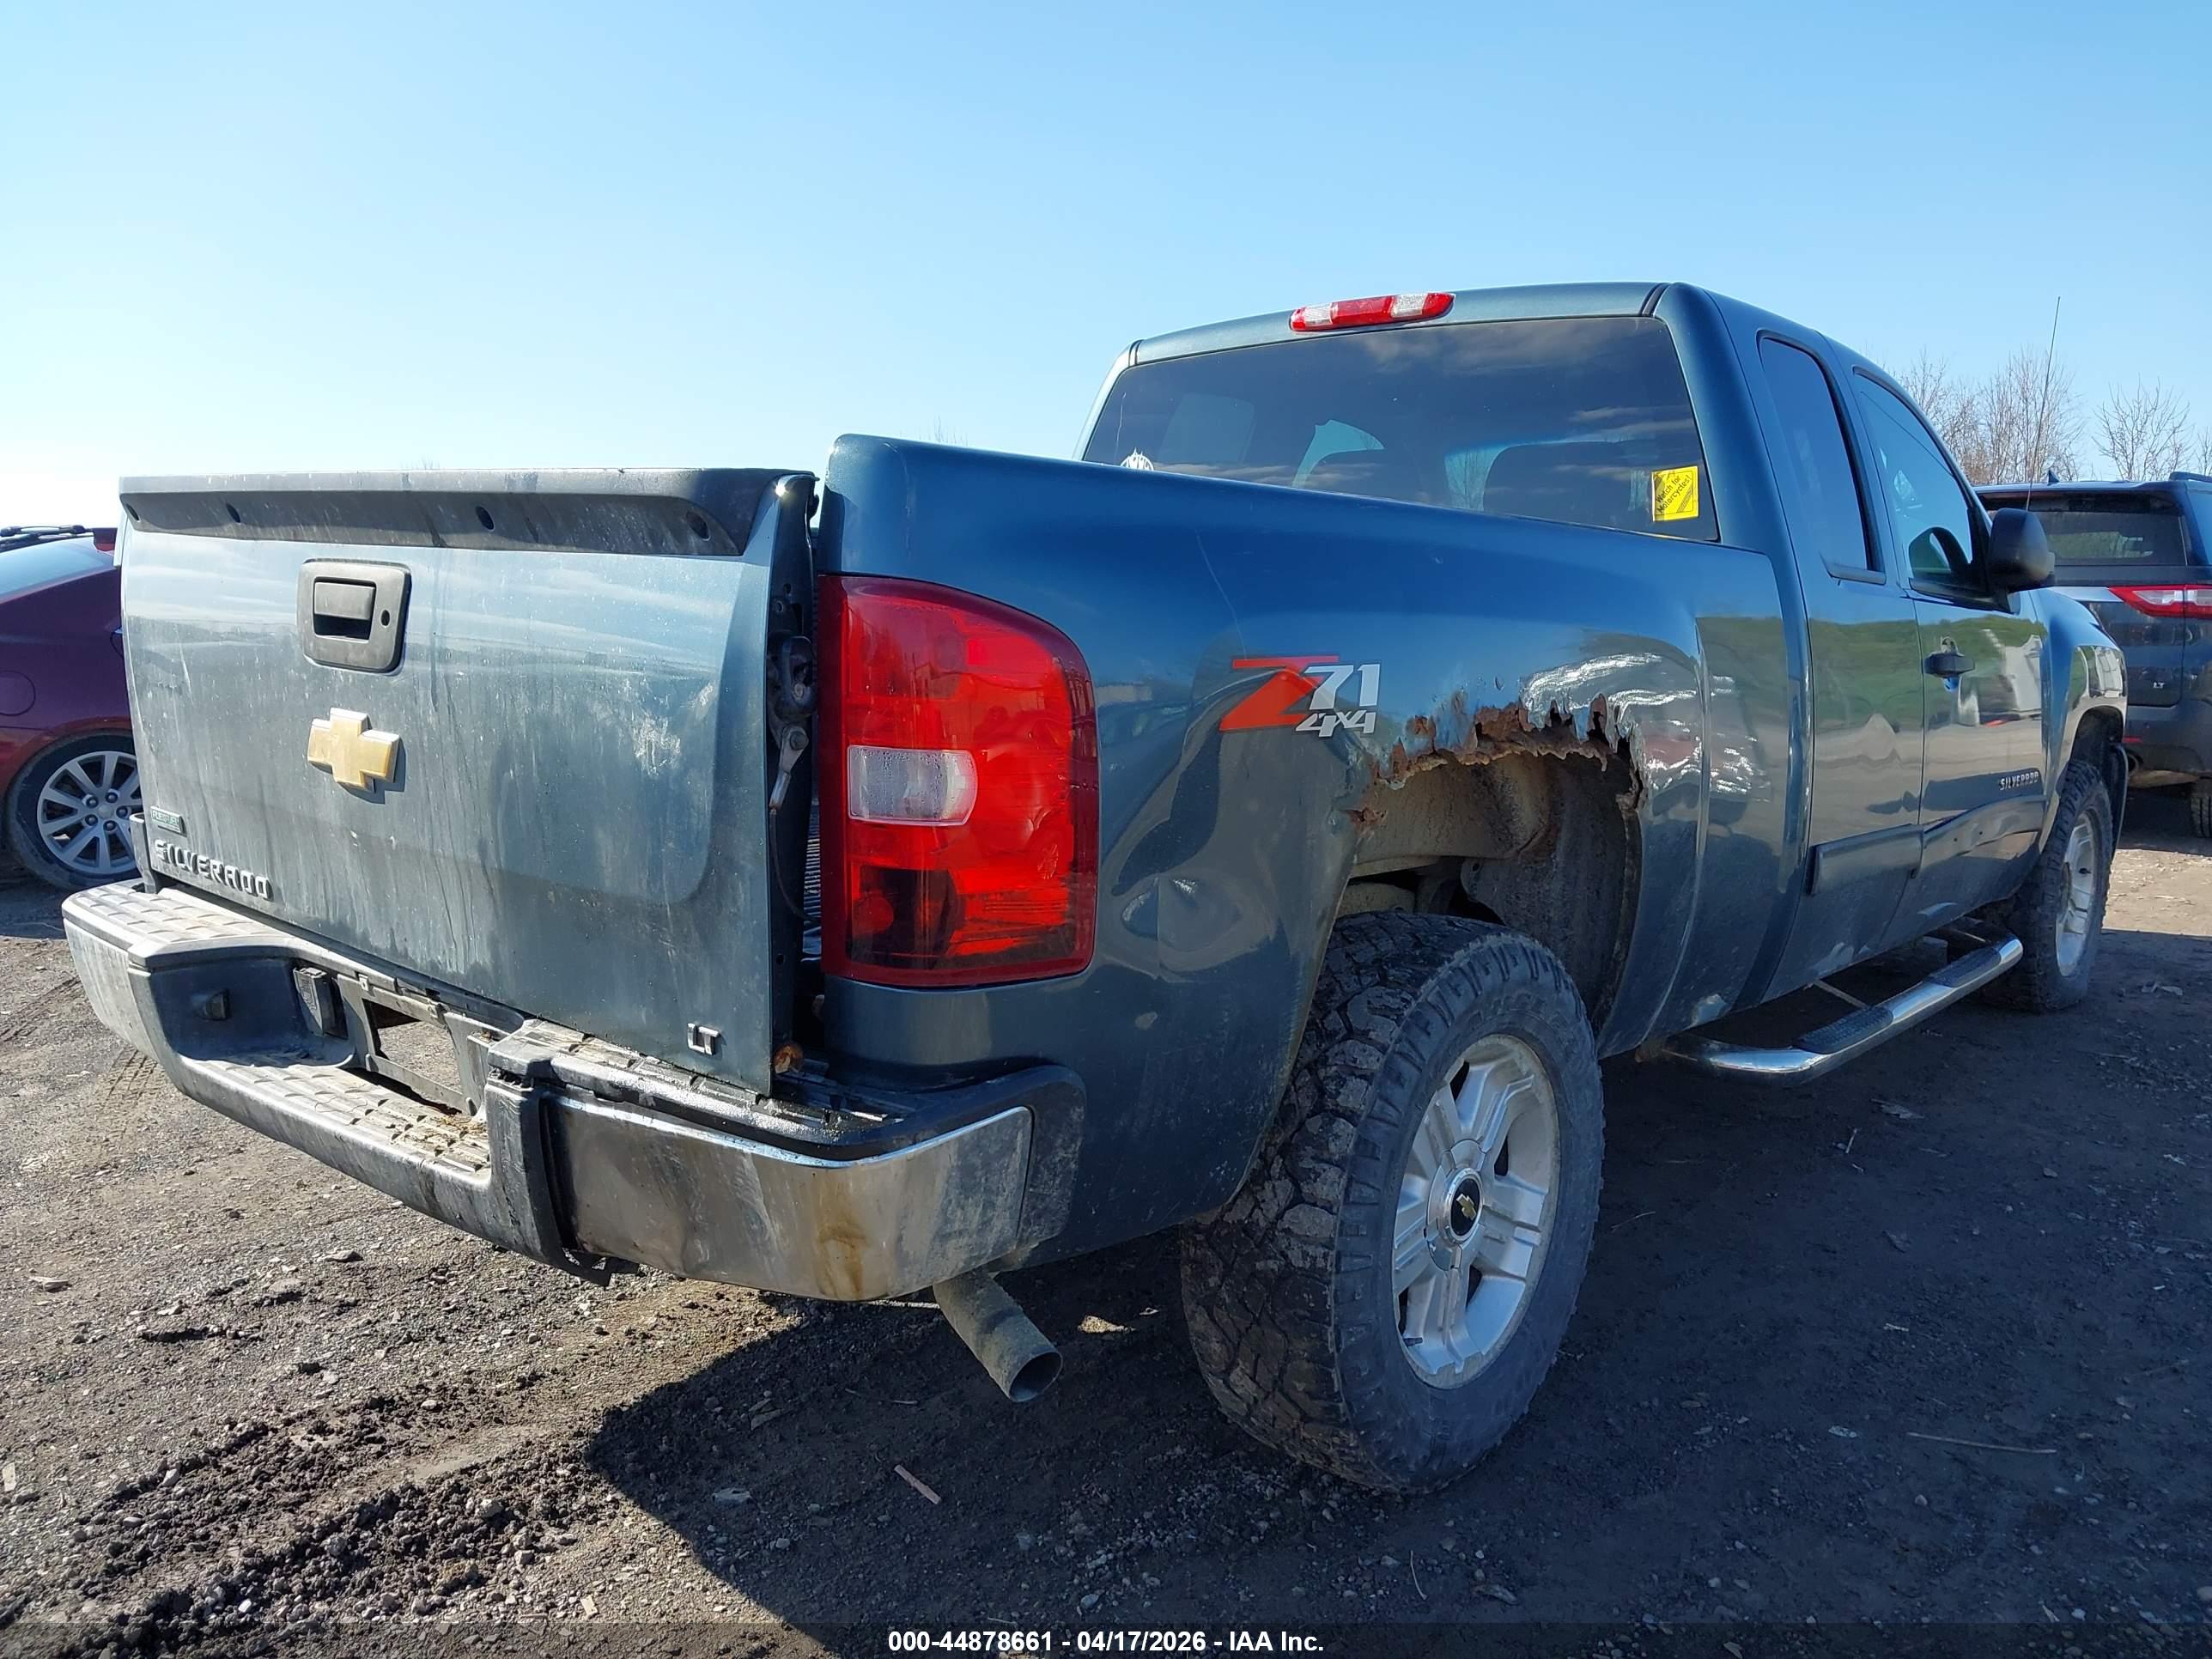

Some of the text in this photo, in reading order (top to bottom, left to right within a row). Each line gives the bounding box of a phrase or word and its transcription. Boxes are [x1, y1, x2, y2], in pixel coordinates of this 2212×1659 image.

[1656, 484, 1674, 503] Watch
[1656, 474, 1692, 514] Motorcycles!
[1219, 655, 1380, 732] Z71
[155, 839, 270, 900] SILVERADO
[687, 1023, 720, 1056] LT
